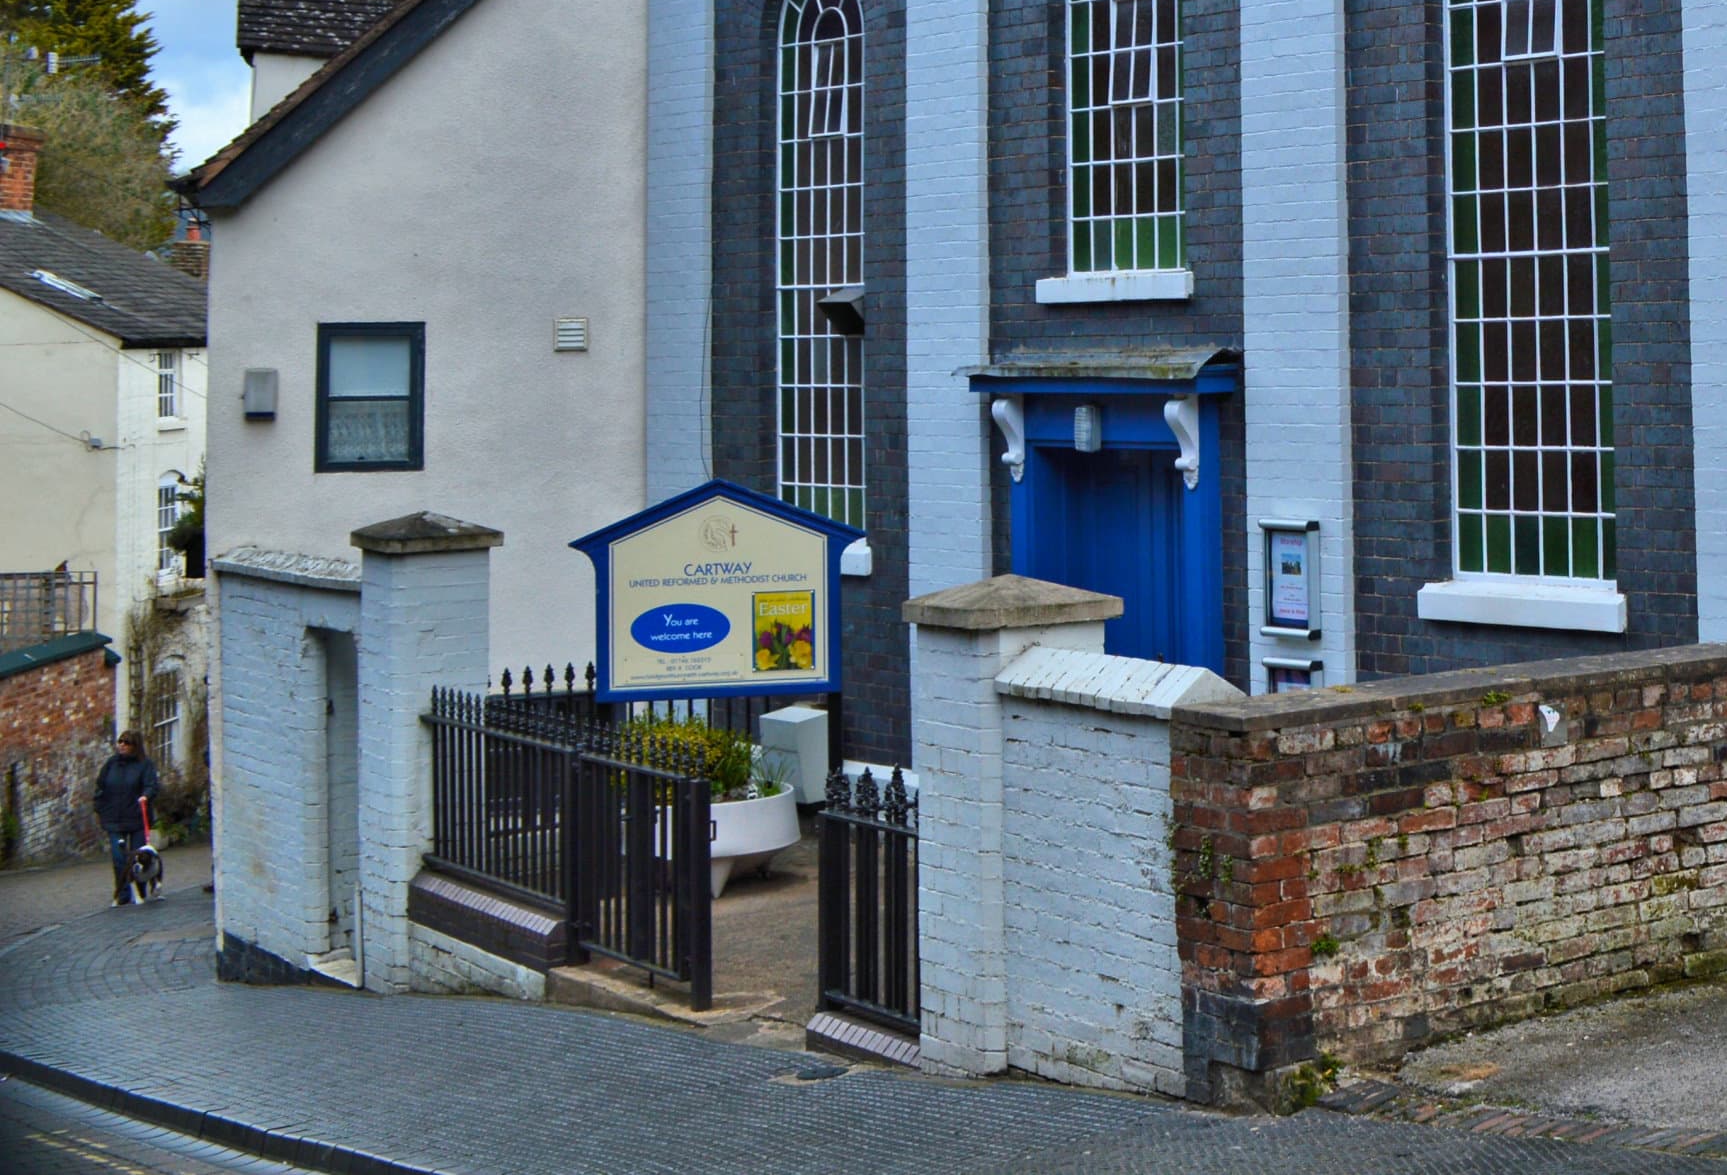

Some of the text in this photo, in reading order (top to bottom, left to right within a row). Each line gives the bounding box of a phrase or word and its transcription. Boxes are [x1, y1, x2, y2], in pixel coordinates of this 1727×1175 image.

[683, 562, 752, 576] CARTWAY
[629, 579, 660, 588] UNITED
[662, 577, 708, 587] REFORMED
[721, 575, 769, 585] METHODIST
[771, 573, 807, 583] CHURCH
[759, 602, 808, 616] Easter
[663, 614, 699, 627] You are
[650, 631, 713, 641] welcome here
